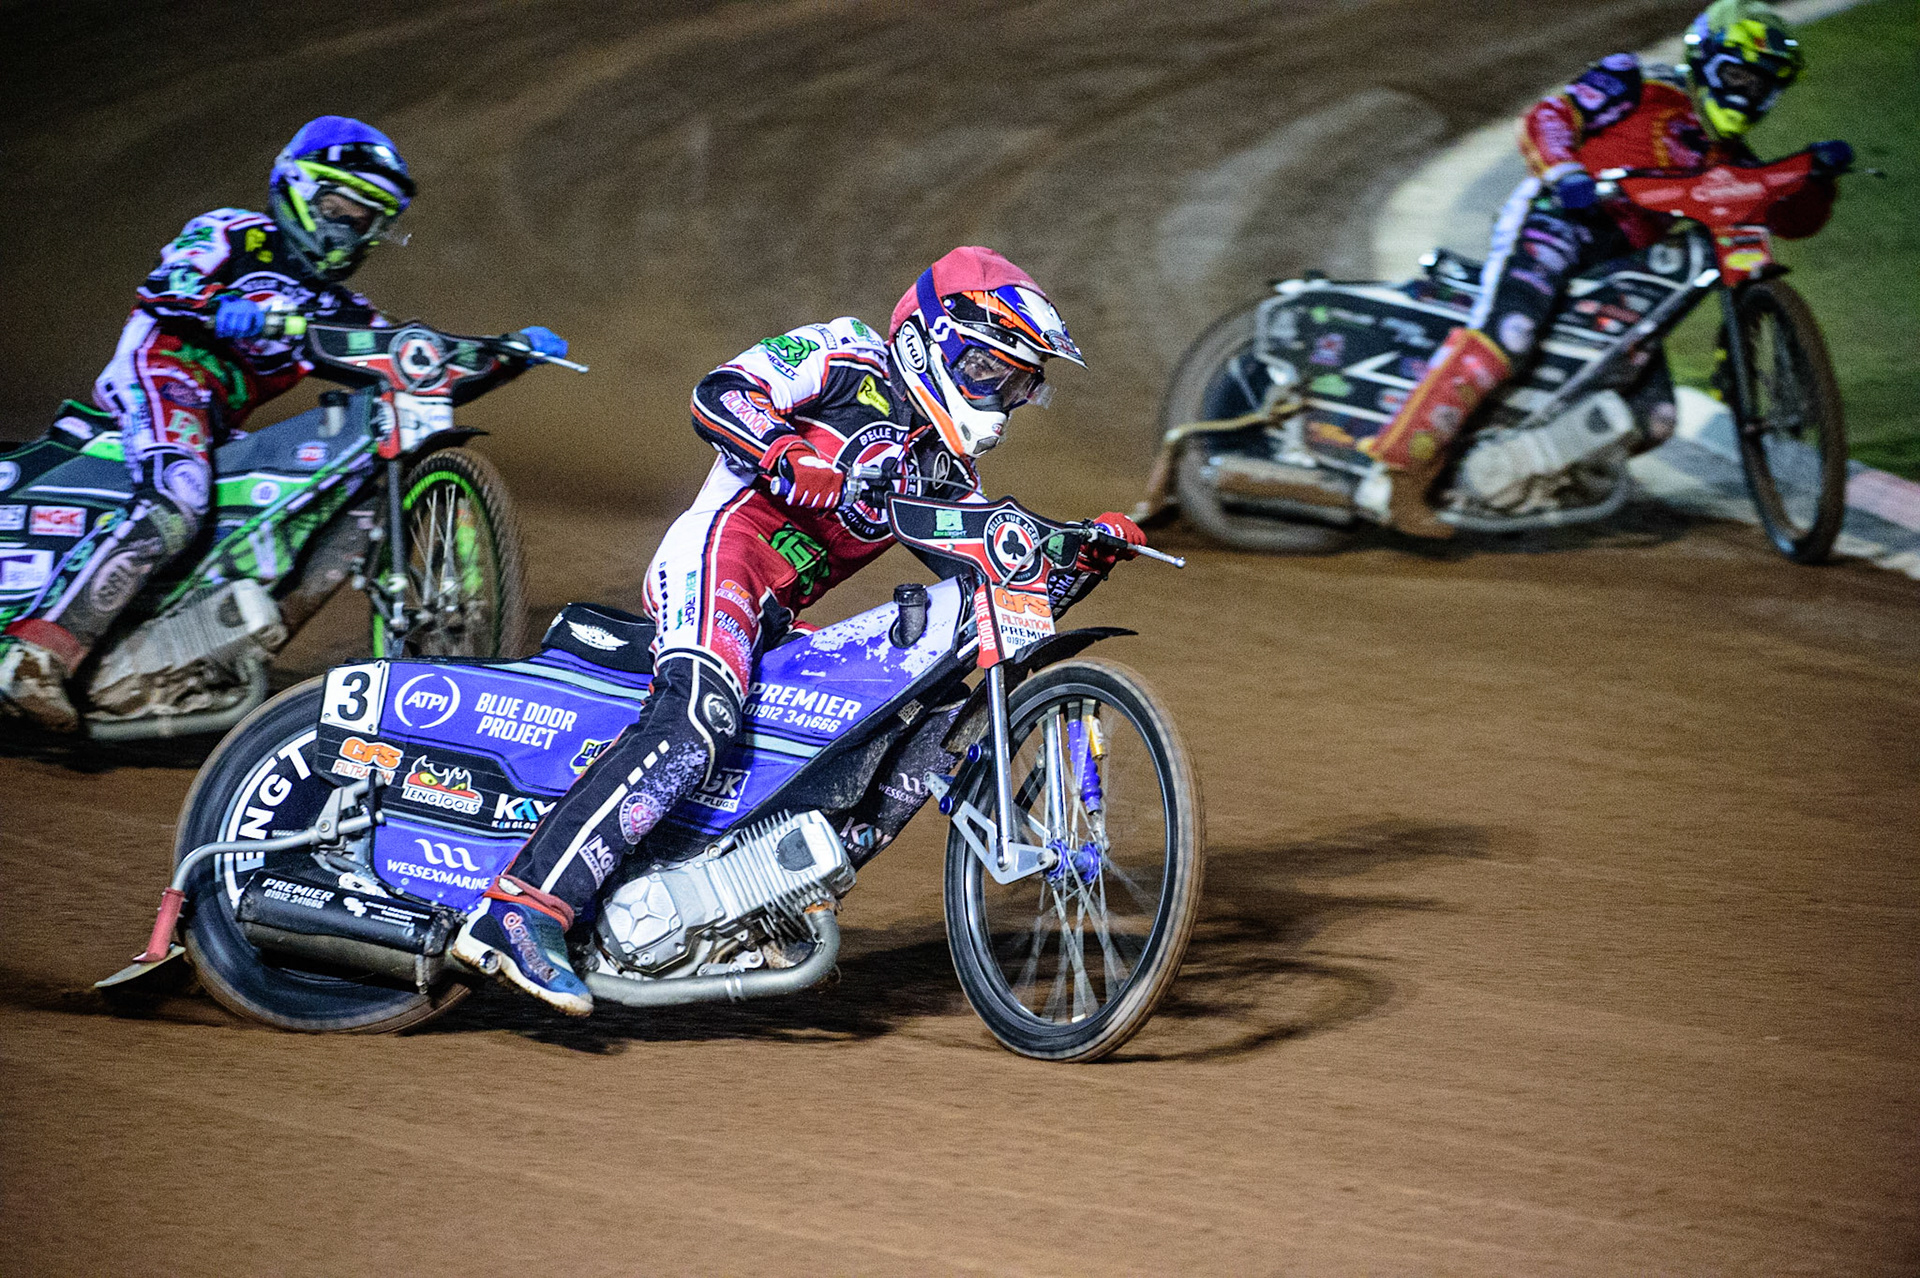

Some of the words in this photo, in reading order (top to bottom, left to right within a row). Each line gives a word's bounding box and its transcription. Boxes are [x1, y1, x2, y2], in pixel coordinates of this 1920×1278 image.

[903, 332, 921, 367] Arai
[859, 427, 892, 447] BELLE
[988, 514, 1004, 536] BELLE
[1004, 514, 1021, 524] VUE
[974, 591, 990, 620] BLUE
[994, 587, 1052, 618] CFS
[714, 610, 740, 631] BLUE
[979, 621, 996, 651] DOOR
[337, 671, 371, 721] 3
[405, 691, 449, 713] ATPI
[749, 682, 862, 721] PREMIER
[475, 692, 524, 719] BLUE
[522, 702, 578, 732] DOOR
[744, 703, 784, 721] 01912
[783, 709, 842, 733] 341666
[476, 715, 558, 750] PROJECT
[342, 738, 401, 768] CFS
[387, 859, 490, 890] WESSEXMARINE
[261, 878, 336, 902] PREMIER
[264, 889, 291, 902] 01912
[290, 894, 325, 910] 341666
